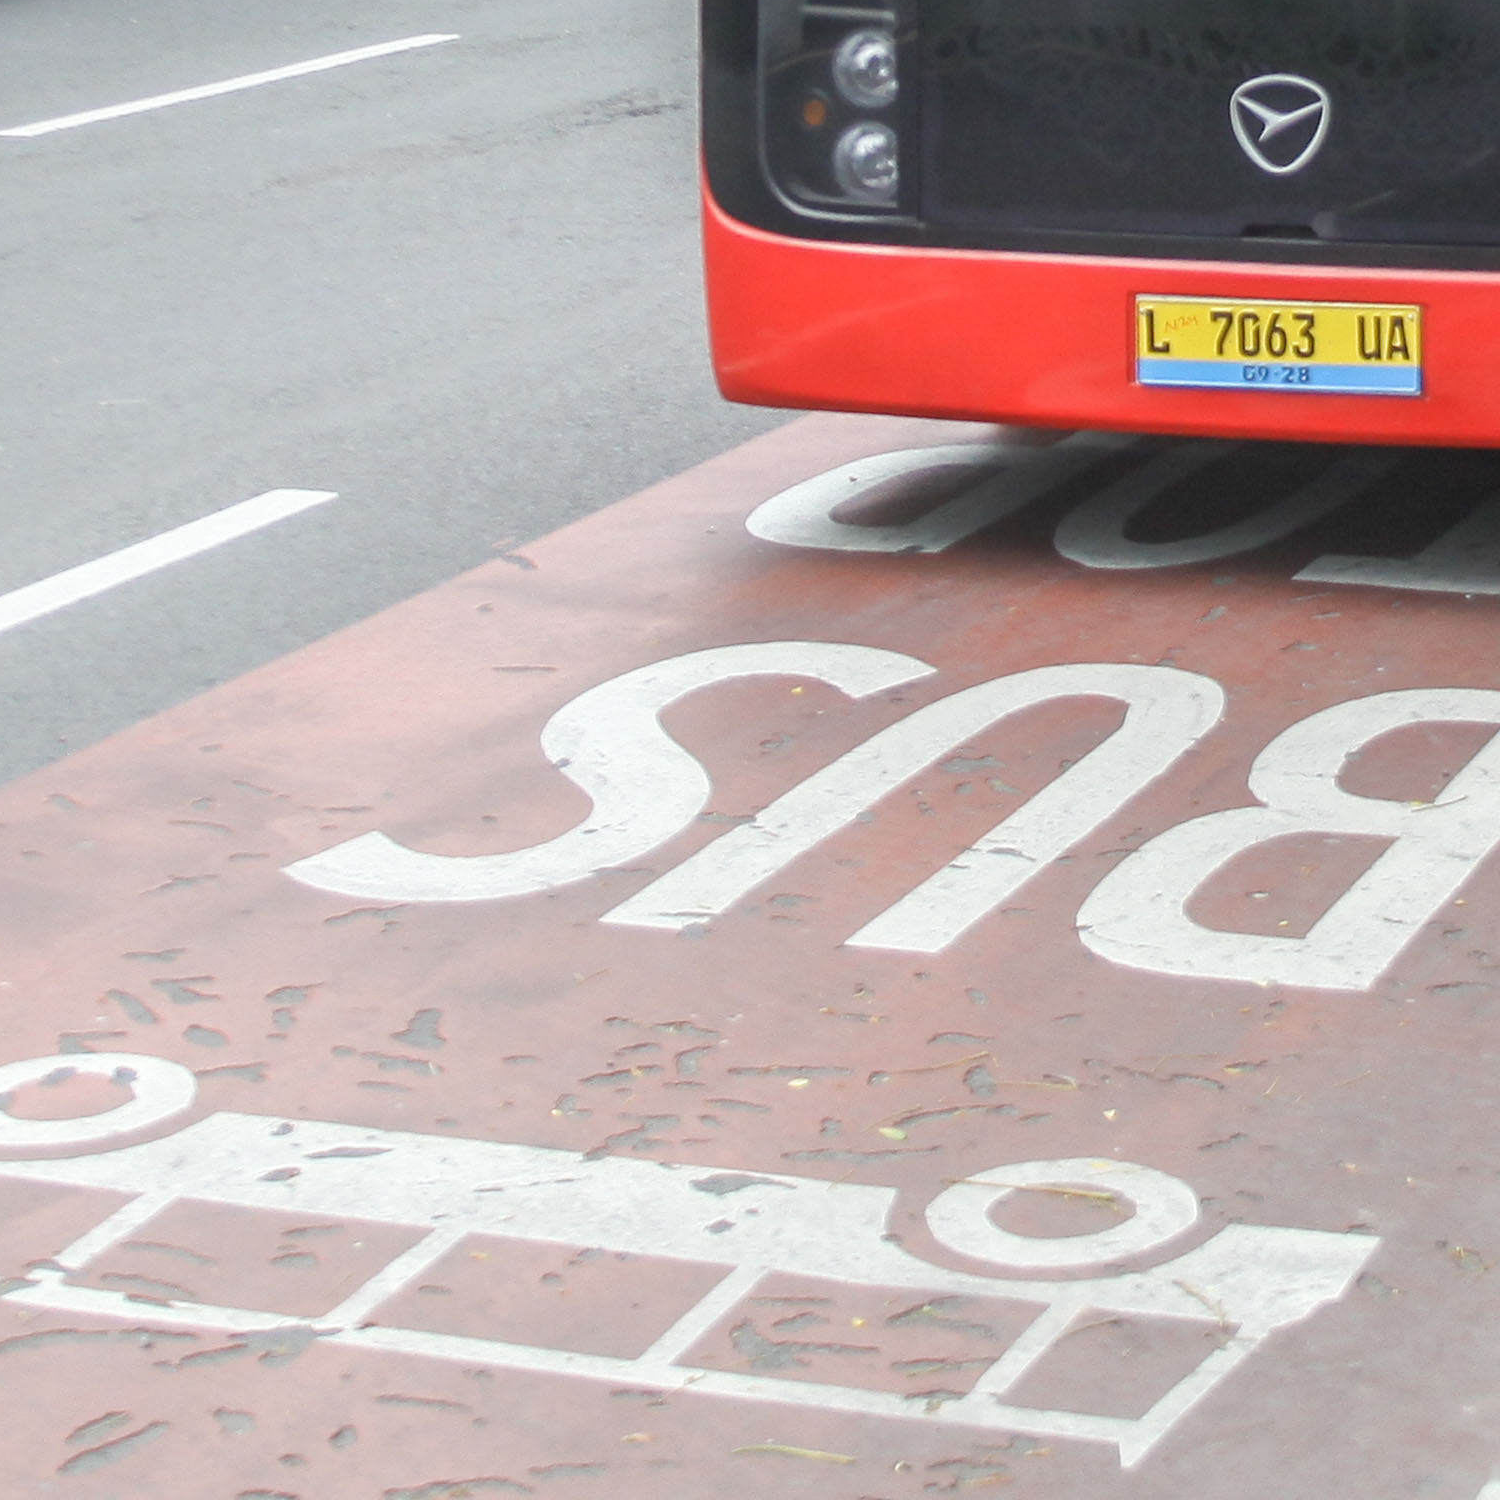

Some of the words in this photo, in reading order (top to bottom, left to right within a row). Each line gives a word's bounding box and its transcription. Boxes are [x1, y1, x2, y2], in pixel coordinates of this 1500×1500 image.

[1145, 308, 1171, 354] L
[1210, 310, 1316, 359] 7063
[1357, 314, 1411, 361] UA
